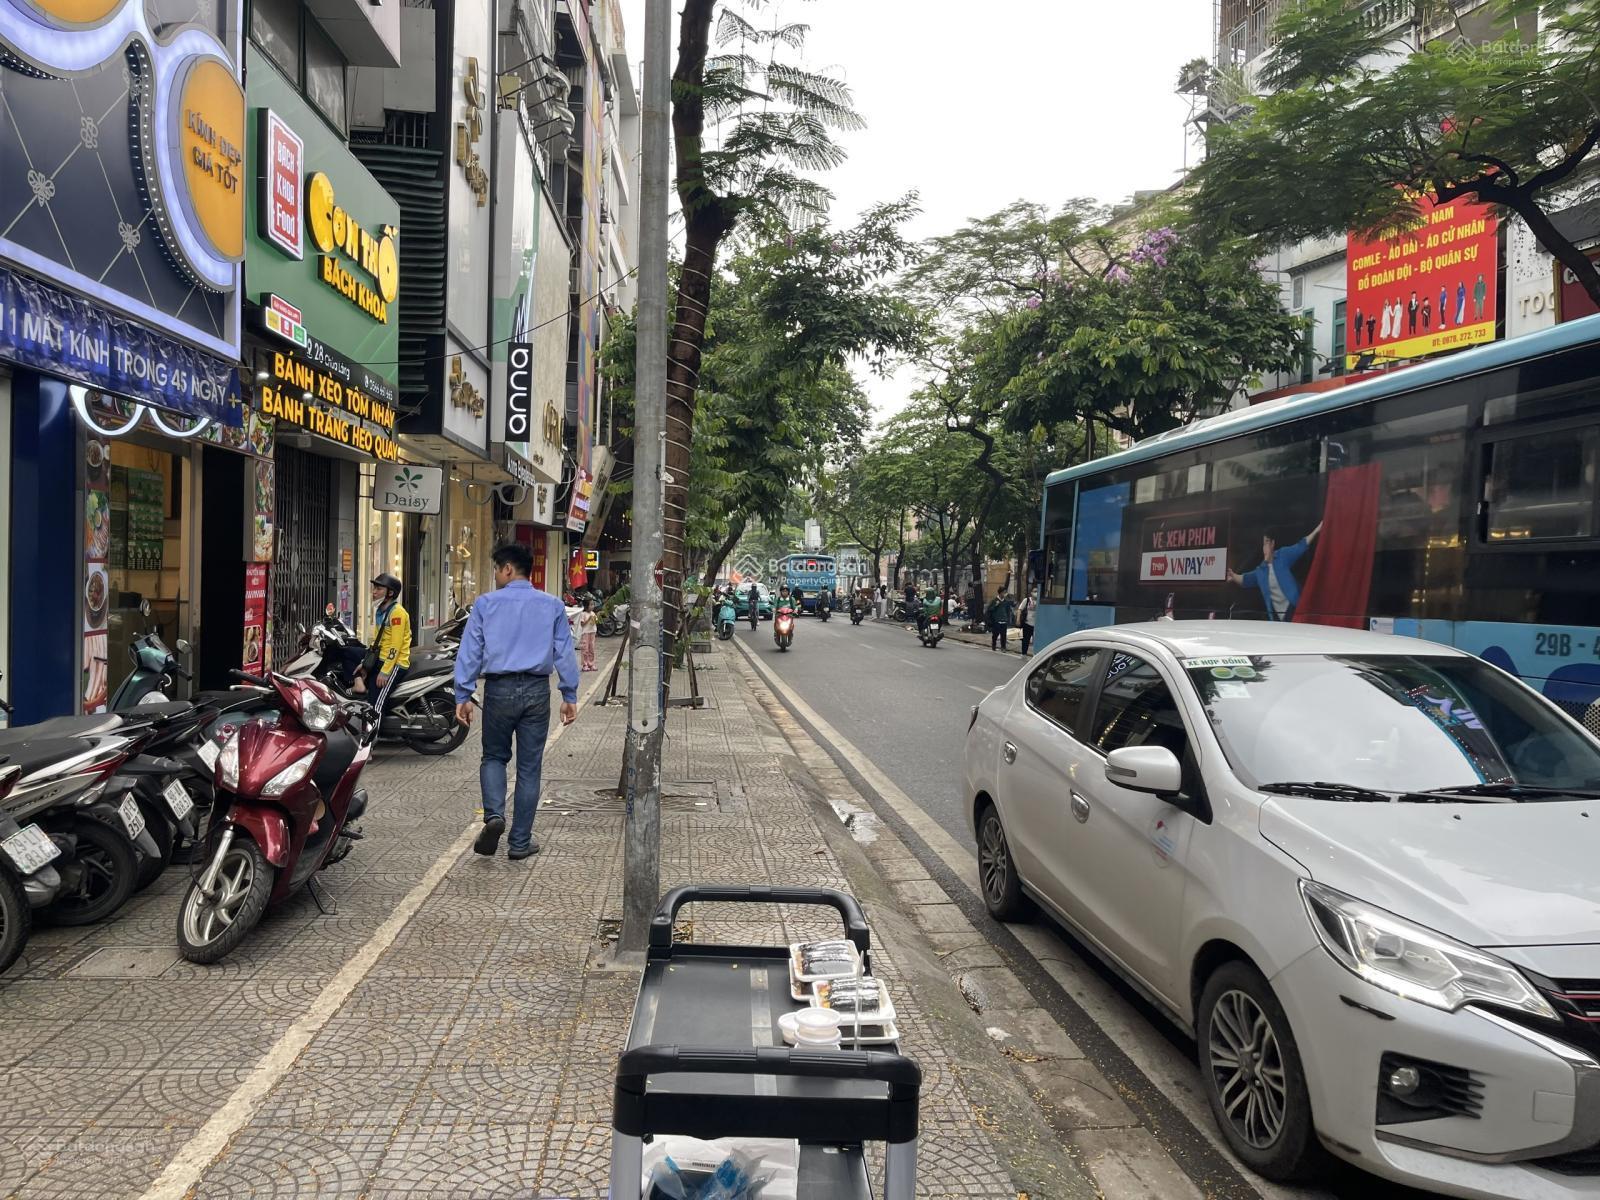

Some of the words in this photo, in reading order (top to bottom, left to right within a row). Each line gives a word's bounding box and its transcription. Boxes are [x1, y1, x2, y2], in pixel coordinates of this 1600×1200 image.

[186, 109, 216, 149] KÍNH
[193, 146, 213, 177] GIÁ
[217, 163, 238, 193] TỐT
[277, 172, 294, 205] KHOA
[276, 203, 295, 238] Food
[1431, 206, 1454, 224] NAM
[1353, 252, 1381, 271] COMLE
[1457, 219, 1485, 240] NHÂN
[1435, 250, 1462, 269] QUÂN
[1464, 243, 1479, 262] SỰ
[324, 256, 356, 301] BÁCH
[359, 284, 387, 325] KHOA
[1474, 328, 1486, 338] 733
[70, 328, 110, 367] KÍNH
[114, 345, 168, 386] TRONG
[171, 368, 187, 393] 45
[275, 351, 314, 393] BÁNH
[319, 372, 342, 405] XÈO
[346, 386, 369, 418] TÔM
[509, 347, 529, 435] anna
[263, 385, 304, 426] BÁNH
[352, 425, 372, 452] HEO
[375, 435, 399, 461] QUAY
[385, 491, 430, 511] Daisy
[1166, 529, 1186, 548] XEM
[1188, 526, 1216, 546] PHIM
[1171, 556, 1205, 575] VNPAY
[1534, 632, 1571, 656] 29B
